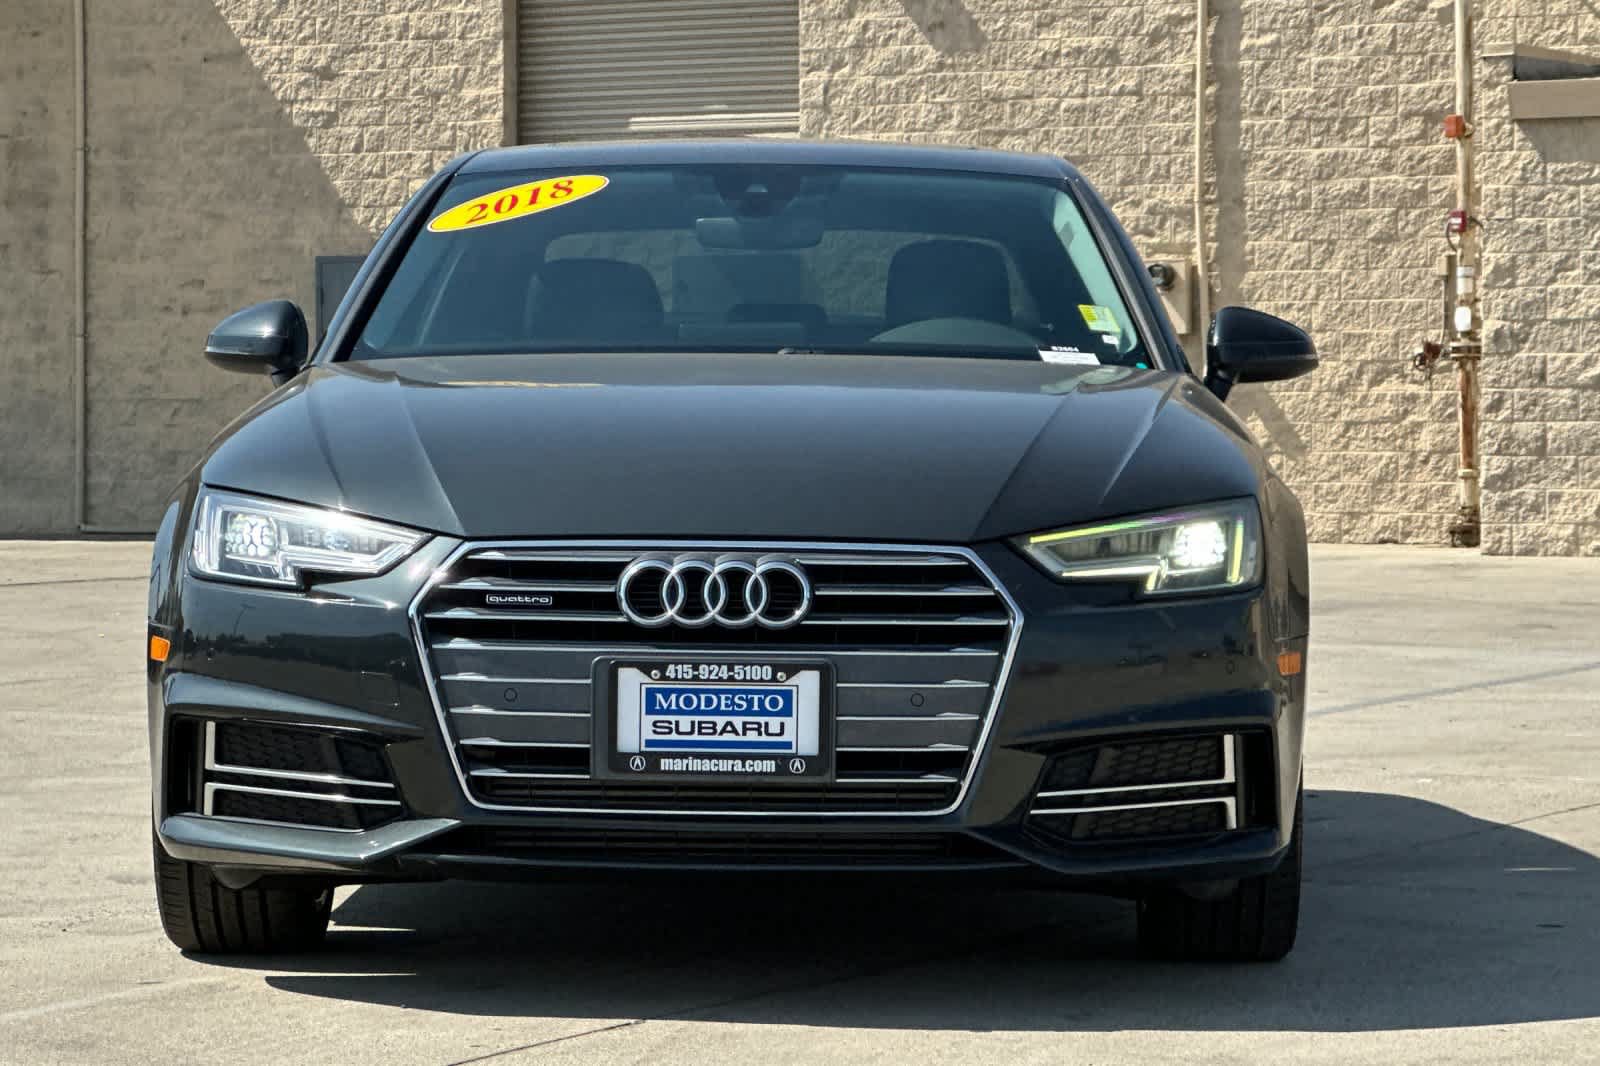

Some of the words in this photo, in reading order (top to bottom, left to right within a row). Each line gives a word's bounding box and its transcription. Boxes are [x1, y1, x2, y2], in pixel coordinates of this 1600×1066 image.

[466, 179, 574, 224] 2018
[488, 595, 550, 604] quattro
[665, 664, 772, 680] 415-924-5100
[654, 693, 785, 711] MODESTO
[652, 720, 785, 737] SUBARU
[660, 757, 776, 773] marinacura.com
